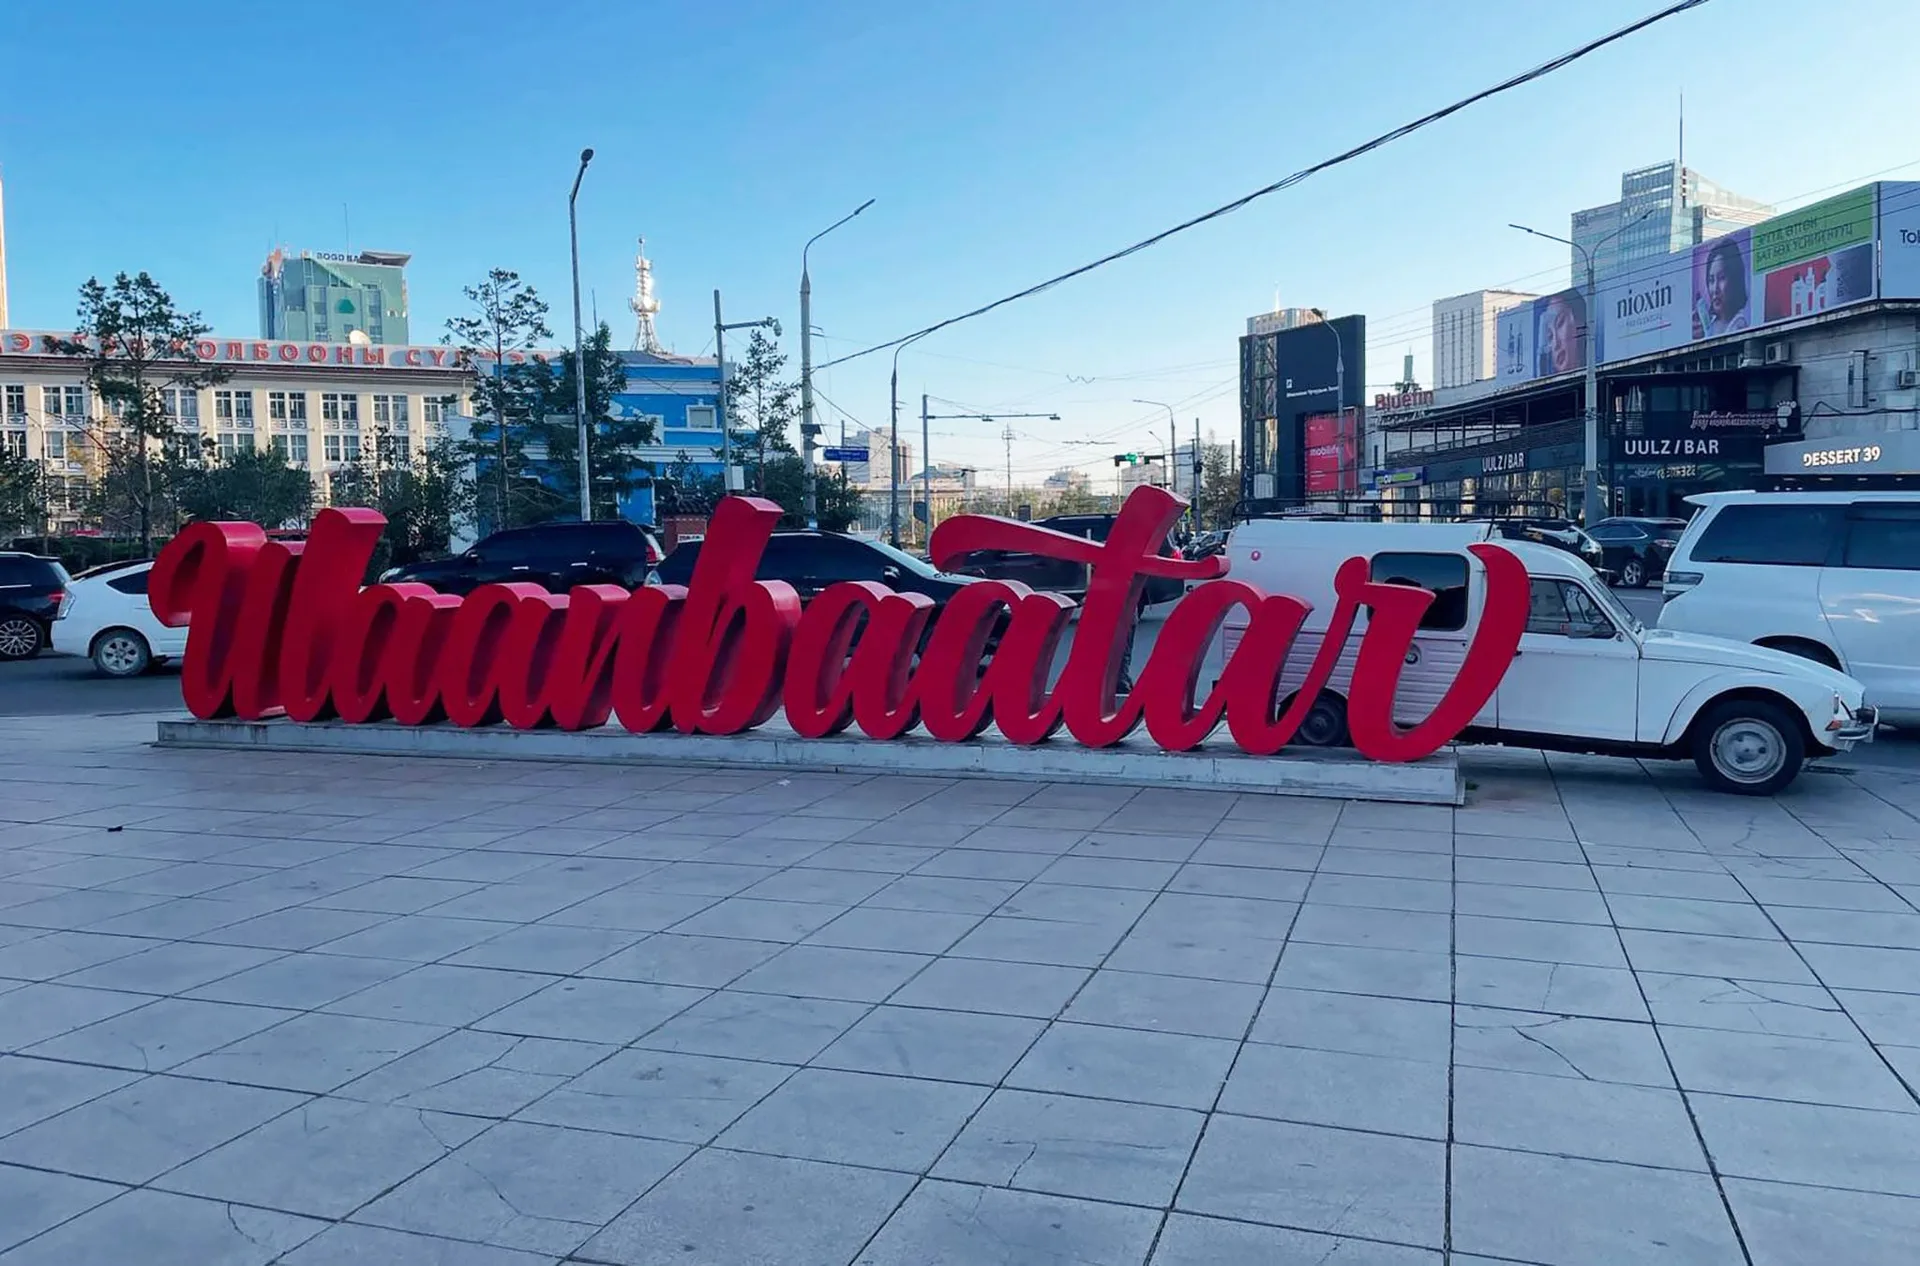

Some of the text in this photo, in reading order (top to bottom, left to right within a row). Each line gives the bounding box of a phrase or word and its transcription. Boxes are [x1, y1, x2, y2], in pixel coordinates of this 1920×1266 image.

[1617, 280, 1672, 319] nioxin
[1803, 446, 1881, 467] DESSERT 39
[148, 484, 1530, 762] Ulaanbaatar
